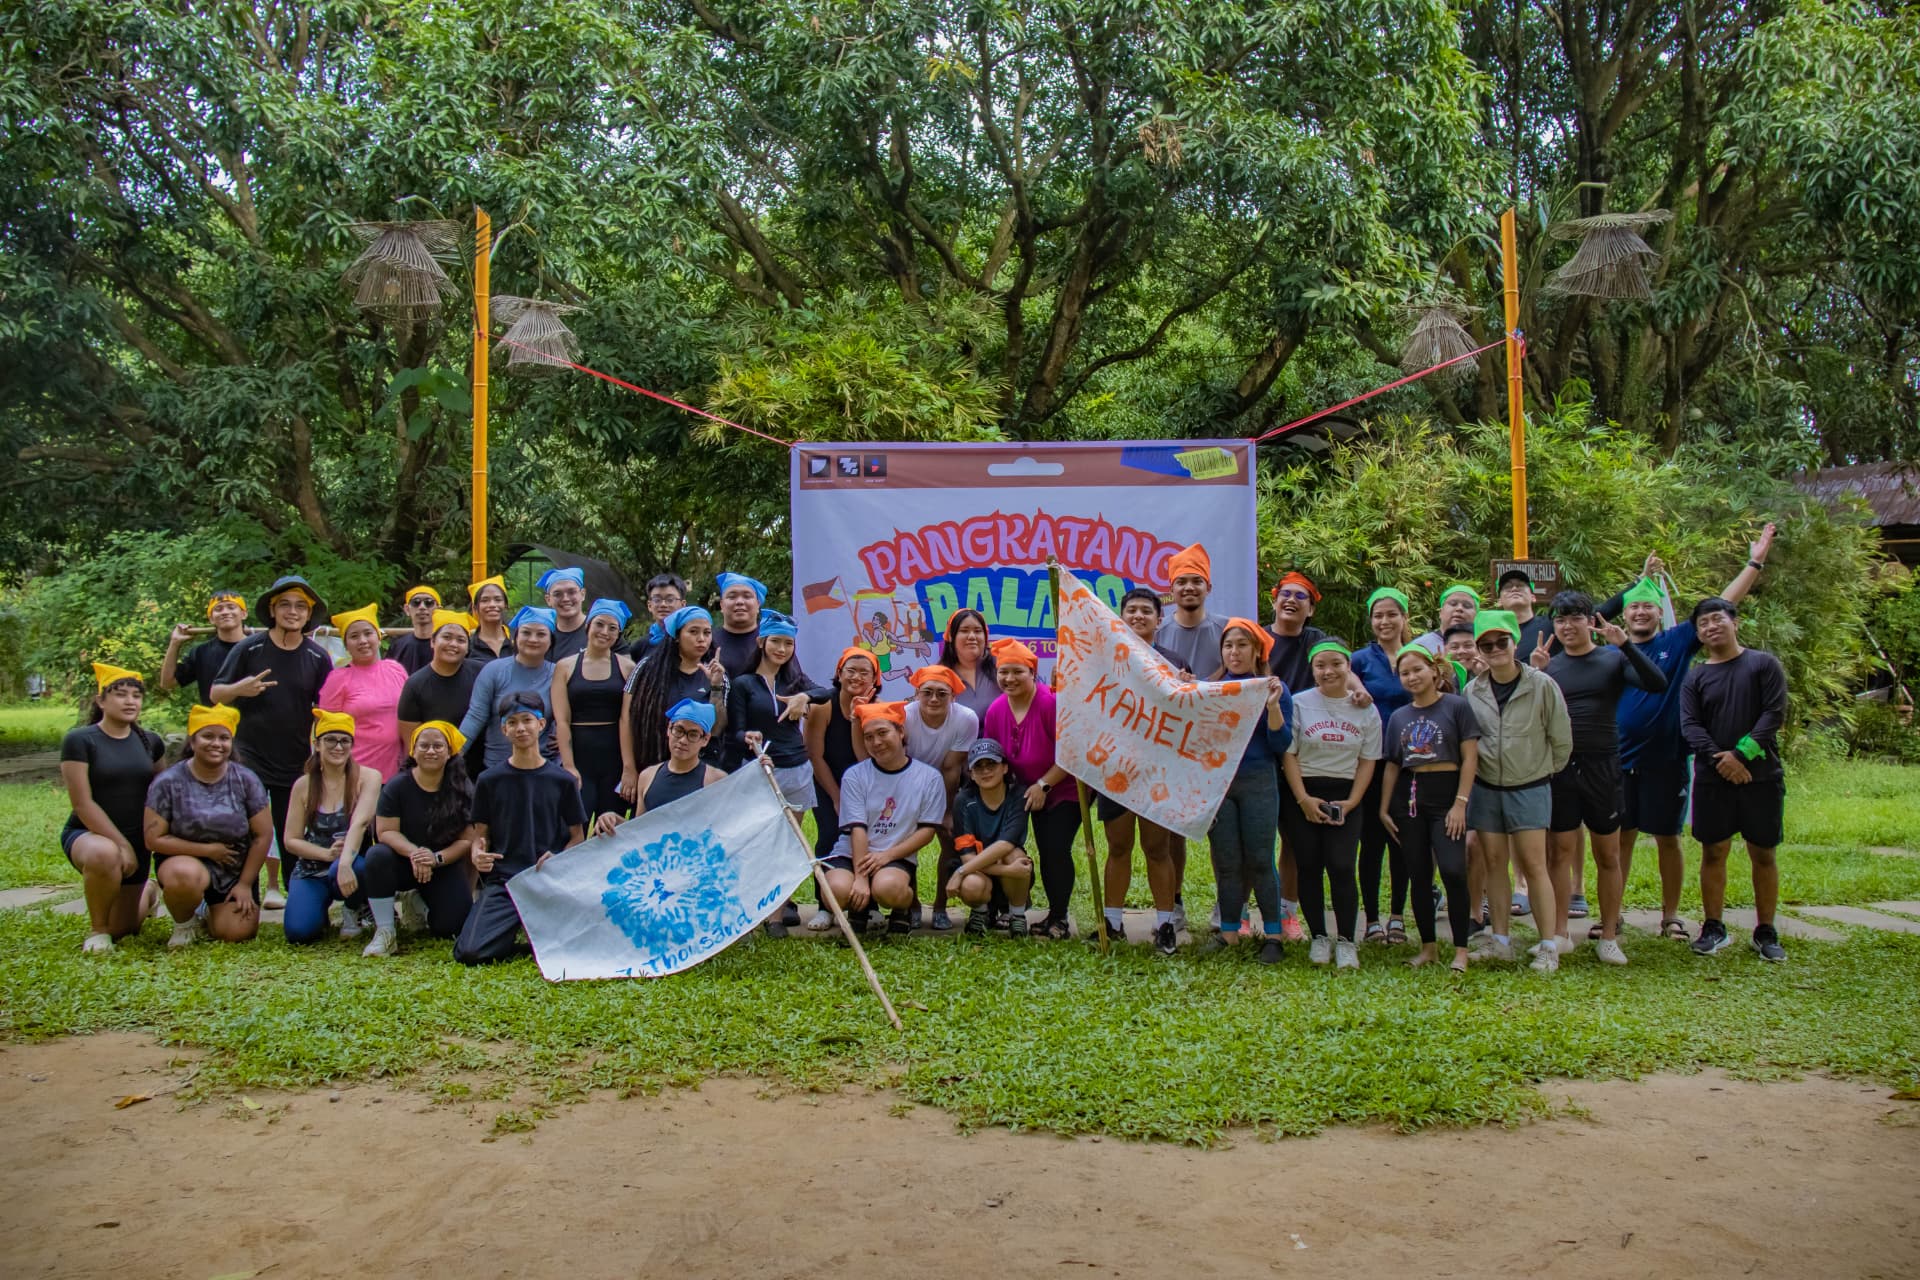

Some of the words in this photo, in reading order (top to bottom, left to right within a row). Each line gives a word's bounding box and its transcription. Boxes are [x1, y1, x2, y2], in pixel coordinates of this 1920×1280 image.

[863, 519, 1180, 589] PANGKATANG
[1538, 563, 1557, 581] FALLS
[925, 575, 1126, 633] PALAO
[1041, 641, 1058, 653] TO
[1084, 674, 1201, 762] KAHEL
[1304, 720, 1340, 738] PHYSICAL
